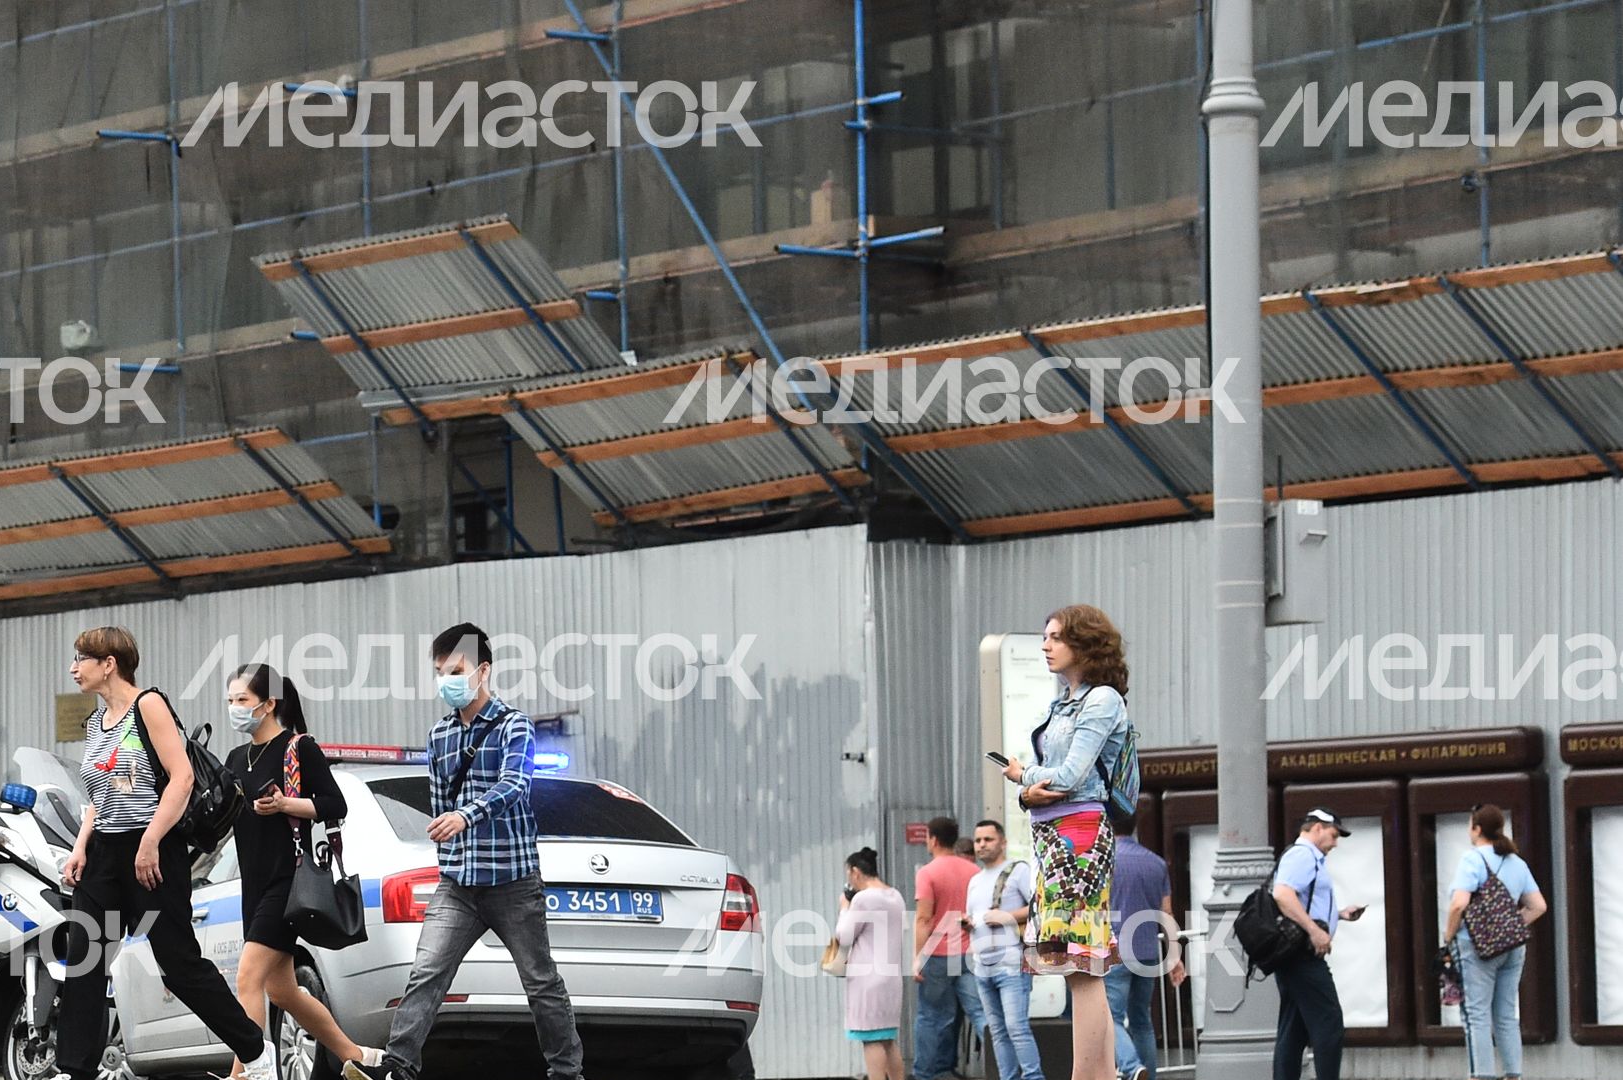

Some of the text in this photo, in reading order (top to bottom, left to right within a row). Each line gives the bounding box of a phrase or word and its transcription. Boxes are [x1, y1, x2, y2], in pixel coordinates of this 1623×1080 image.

[1144, 742, 1506, 775] ГОСУДАРСТ АКАДЕМИЧЕСКАЯ ФИЛАРМОНИЯ
[567, 890, 621, 912] 3451
[632, 892, 654, 908] 99
